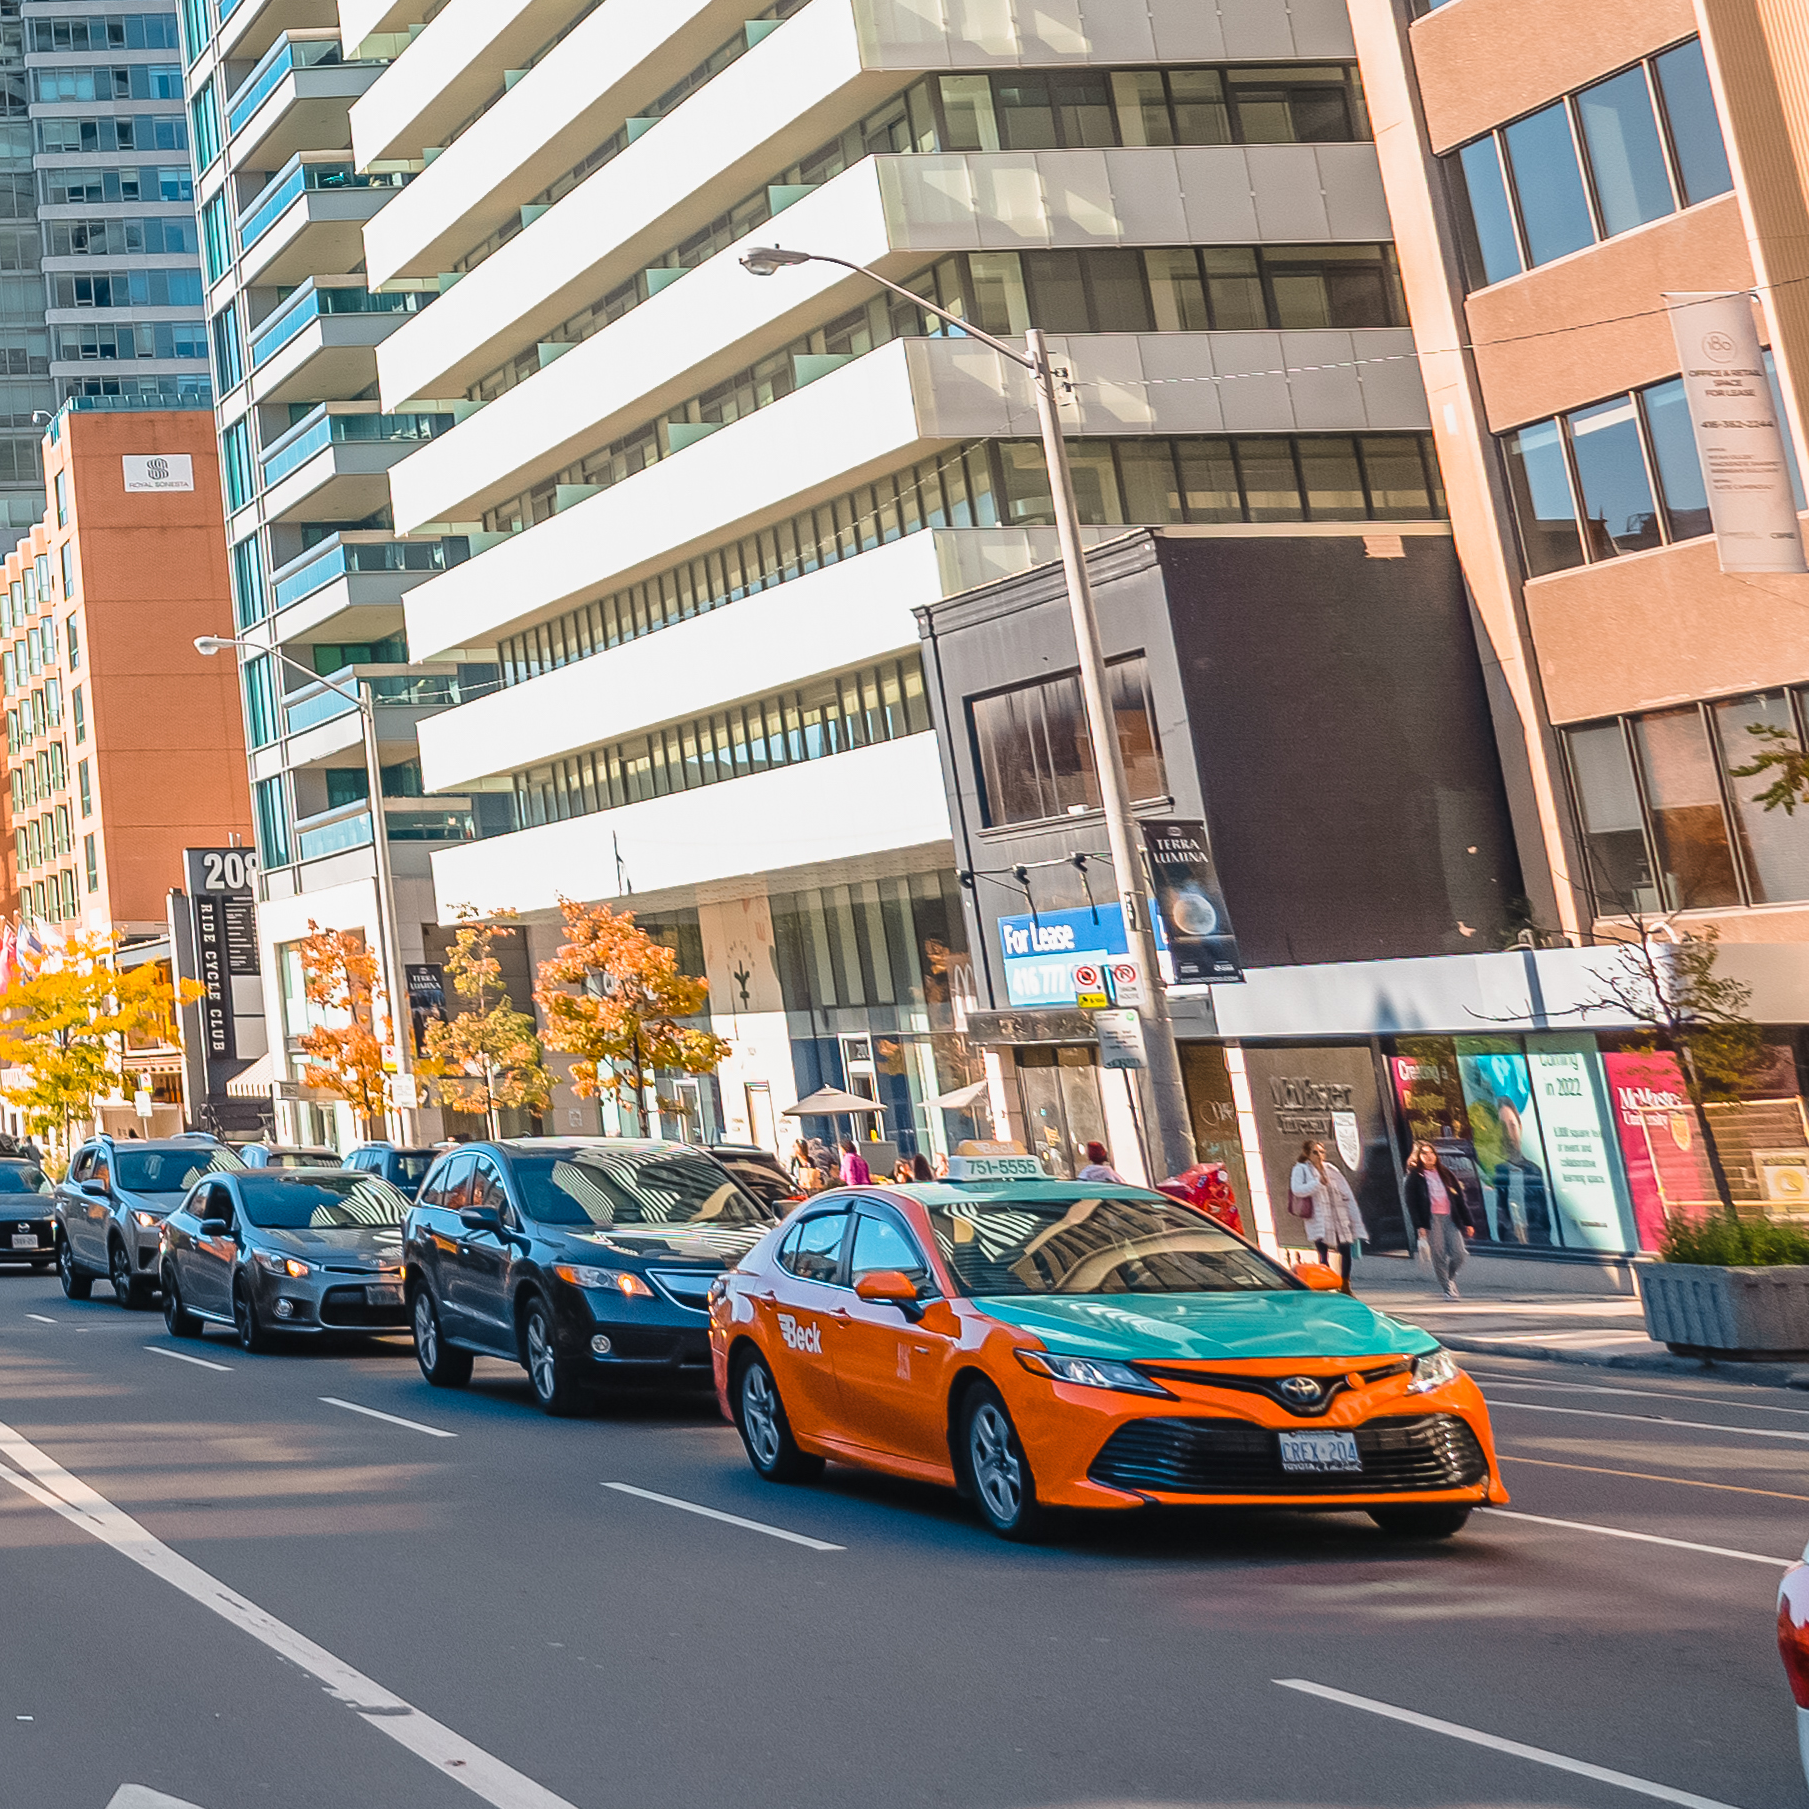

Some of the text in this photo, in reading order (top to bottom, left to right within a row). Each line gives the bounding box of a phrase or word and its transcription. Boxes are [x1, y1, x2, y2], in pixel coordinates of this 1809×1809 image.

[1727, 389, 1757, 397] LEASE
[1156, 839, 1200, 850] TERRA
[1153, 851, 1209, 863] LUMINA
[1003, 921, 1075, 954] For Lease
[200, 903, 225, 1051] RIDE CYCLE CLUB
[412, 974, 437, 983] TERRA
[1012, 966, 1040, 996] 416
[1041, 964, 1067, 994] 777
[1397, 1059, 1440, 1084] Creating
[1270, 1076, 1354, 1110] McMaster
[1542, 1076, 1583, 1096] in 2022
[972, 1142, 1017, 1154] Beck
[966, 1159, 1037, 1175] 751-5555
[778, 1313, 823, 1354] Beck
[1283, 1441, 1319, 1462] CREX
